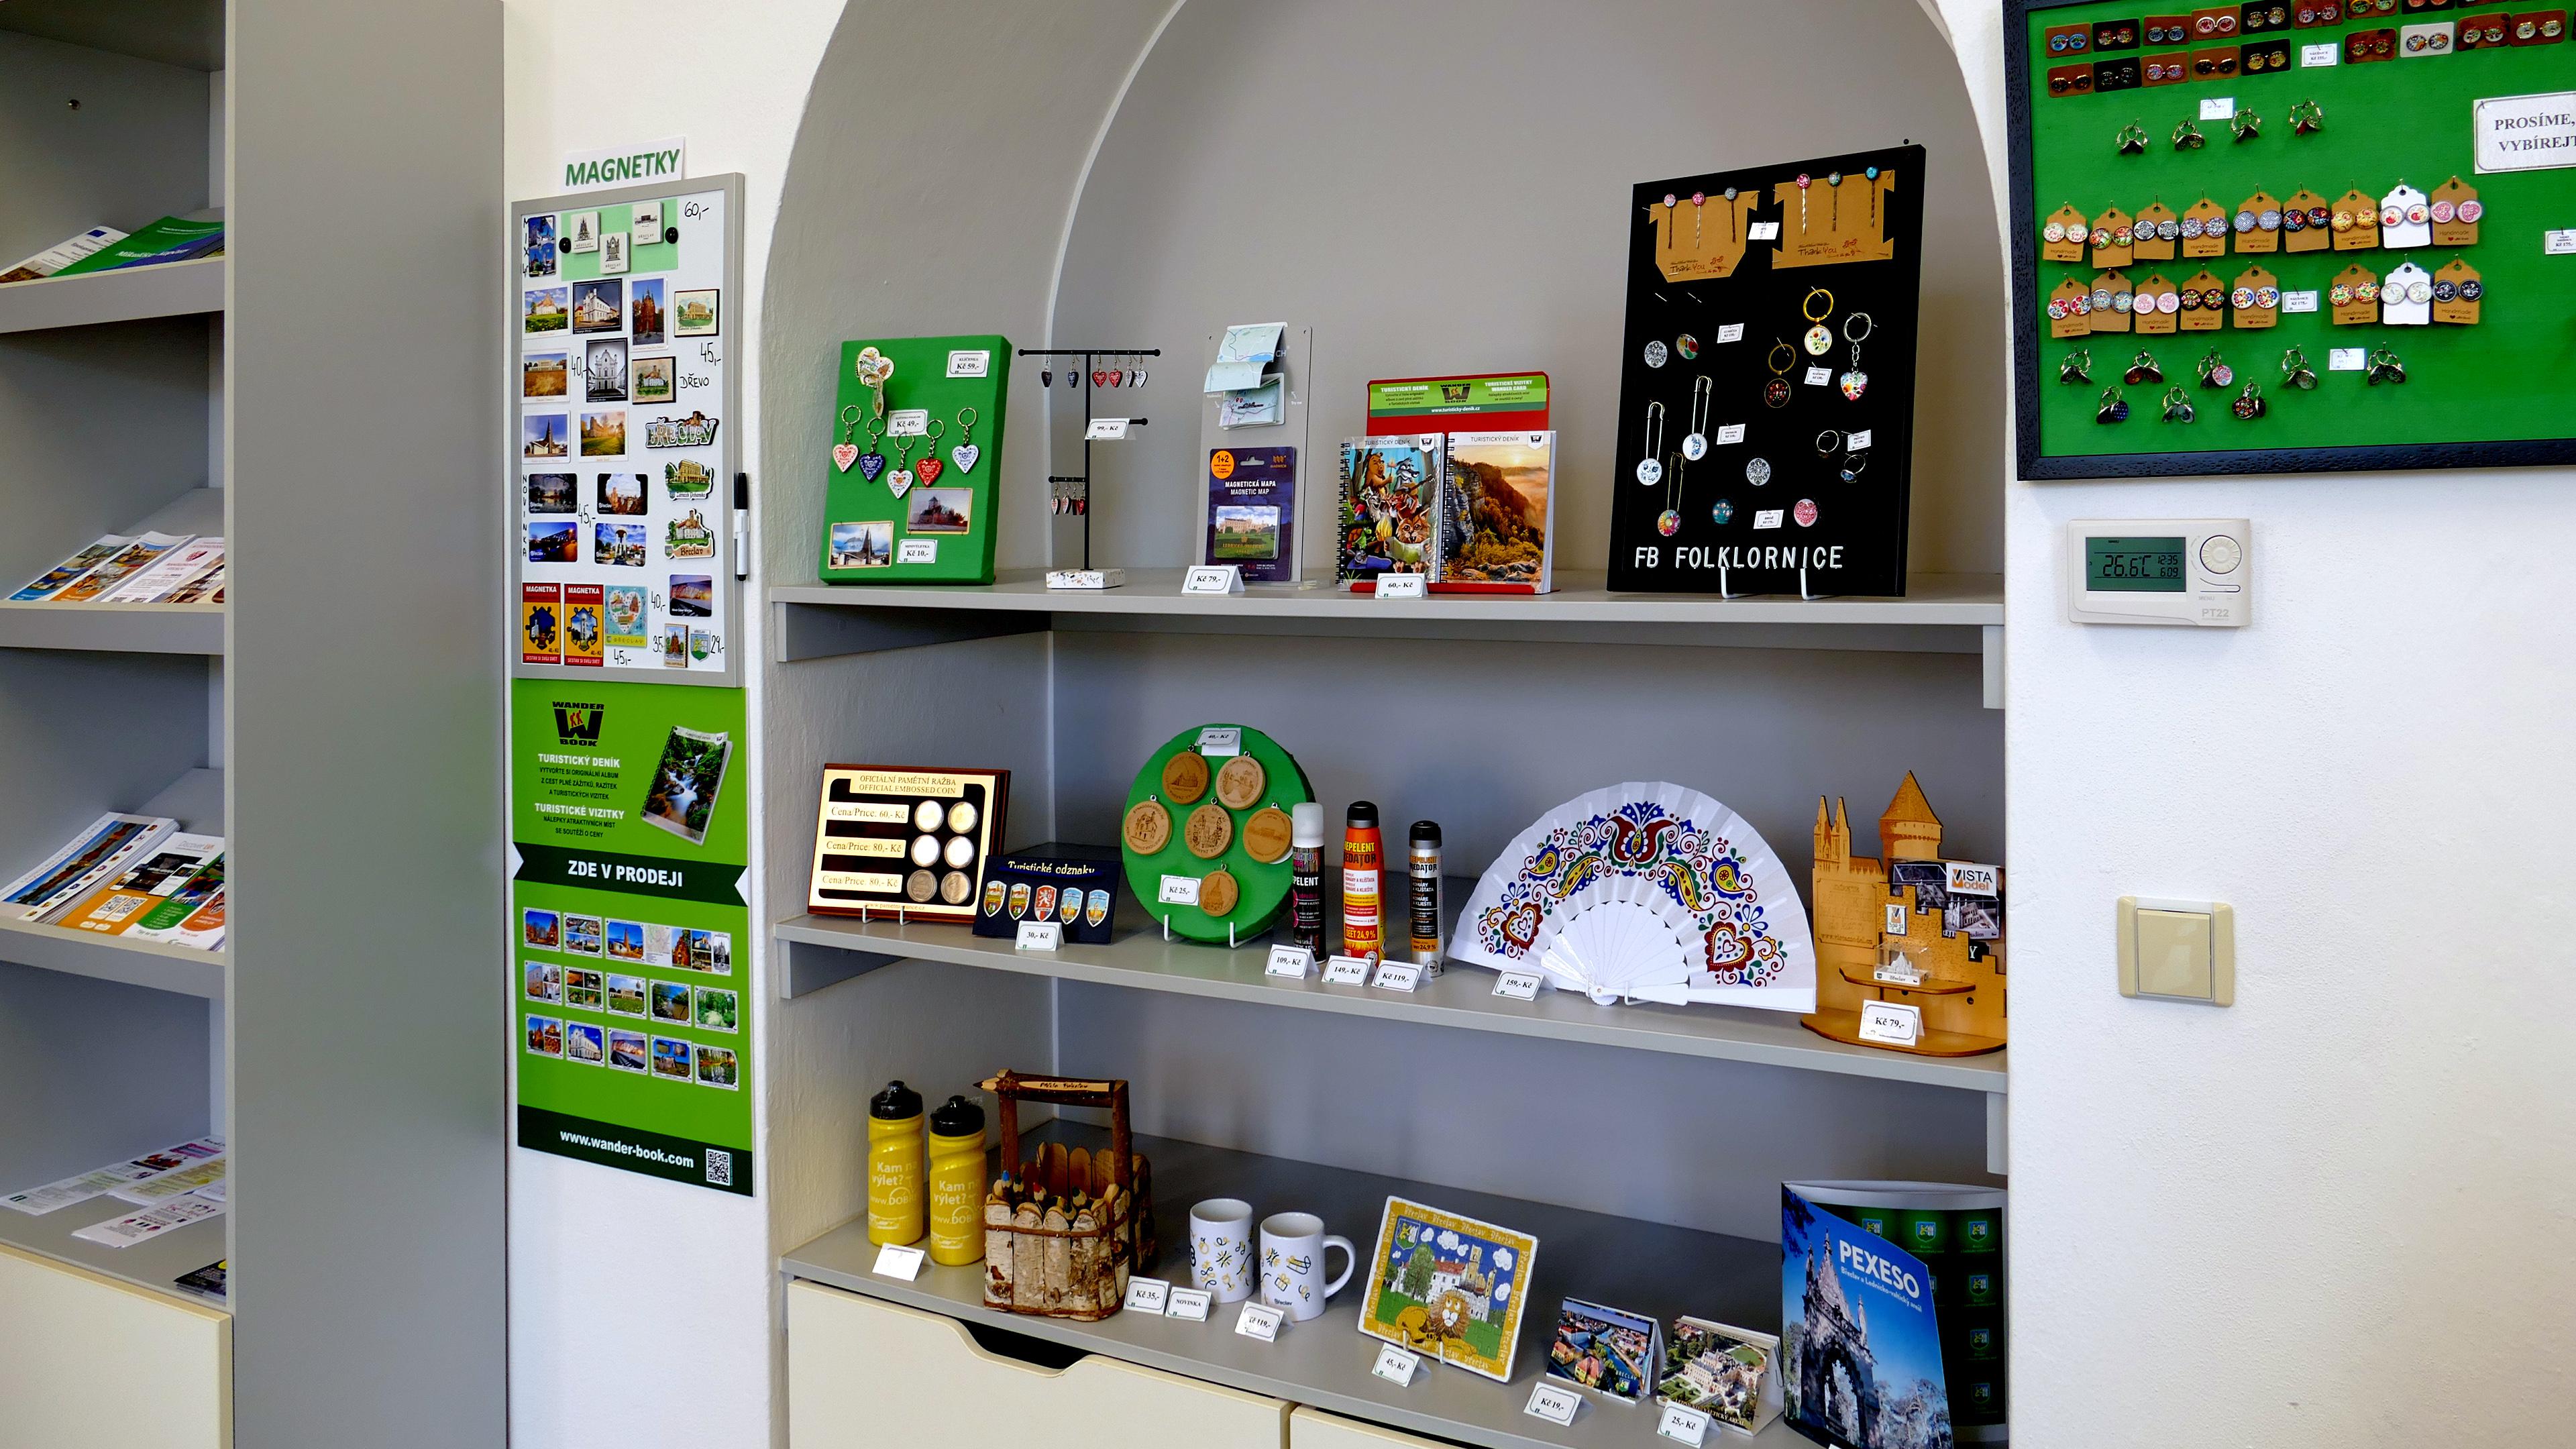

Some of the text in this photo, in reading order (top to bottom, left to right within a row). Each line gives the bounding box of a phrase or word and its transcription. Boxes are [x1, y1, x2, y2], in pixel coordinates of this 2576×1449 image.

[2495, 113, 2575, 130] PROSÍME,
[566, 148, 680, 186] MAGNETKY
[684, 201, 709, 220] 60,-
[1799, 248, 1822, 257] Thank
[700, 342, 721, 366] 45,-
[680, 372, 710, 388] DŘEVO
[646, 417, 716, 447] BŘECLAV
[1216, 455, 1229, 463] 1+2
[1225, 479, 1260, 488] MAGNETICKÁ
[578, 503, 596, 528] 45,-
[680, 547, 703, 556] Břeclav
[1635, 546, 1843, 569] FB FOLKLORNICE
[651, 591, 665, 612] 40,-
[2202, 608, 2229, 617] PT22
[710, 635, 724, 654] 29,-
[614, 649, 631, 665] 45,-
[552, 701, 604, 710] WANDER
[559, 739, 597, 747] BOOK
[538, 753, 620, 767] TURISTICKÝ DENÍK
[572, 769, 600, 777] ORIGINÁLNÍ
[860, 775, 957, 786] OFICIÁLNÍ PAMĚTNÍ RAŽBA
[554, 790, 589, 798] TURISTICKÝCH
[859, 784, 893, 792] OFFICIAL
[895, 786, 936, 794] EMBOSSED
[535, 803, 625, 819] TURISTICKÉ VIZITKY
[831, 806, 905, 819] Cena/Price: 60,- Kč
[567, 818, 602, 827] ATRAKTIVNÍCH
[826, 841, 902, 853] Cena/Price: 80,- Kč
[568, 860, 682, 887] ZDE V PRODEJI
[1008, 861, 1095, 875] Turistické odznaky
[822, 875, 898, 887] Cena/Price: 80,- Kč
[1169, 885, 1190, 895] Kč 25,-
[1346, 928, 1376, 939] DEET 24,9 %
[1276, 957, 1301, 966] 109,- Kč
[1334, 966, 1349, 974] 149,-
[1393, 974, 1409, 982] 119,-
[1505, 979, 1521, 987] 159,-
[1876, 1017, 1905, 1028] Kč 79,-
[559, 1130, 694, 1169] www.wander-book.com
[877, 1162, 902, 1173] Kam
[873, 1175, 904, 1187] výlet?
[940, 1181, 965, 1191] Kam
[934, 1193, 966, 1205] výlet?
[1839, 1239, 1920, 1299] PEXESO
[1841, 1266, 1861, 1281] Břeclav
[1865, 1277, 1910, 1307] Lednicko-valtický
[1136, 1290, 1160, 1301] Kč 35,-
[1176, 1299, 1201, 1307] NOVINKA
[1256, 1318, 1271, 1328] 119,-
[1386, 1358, 1406, 1371] 45,- Kč
[1540, 1397, 1564, 1411] Kč 19,-
[1672, 1416, 1697, 1430] 25,- Kč
